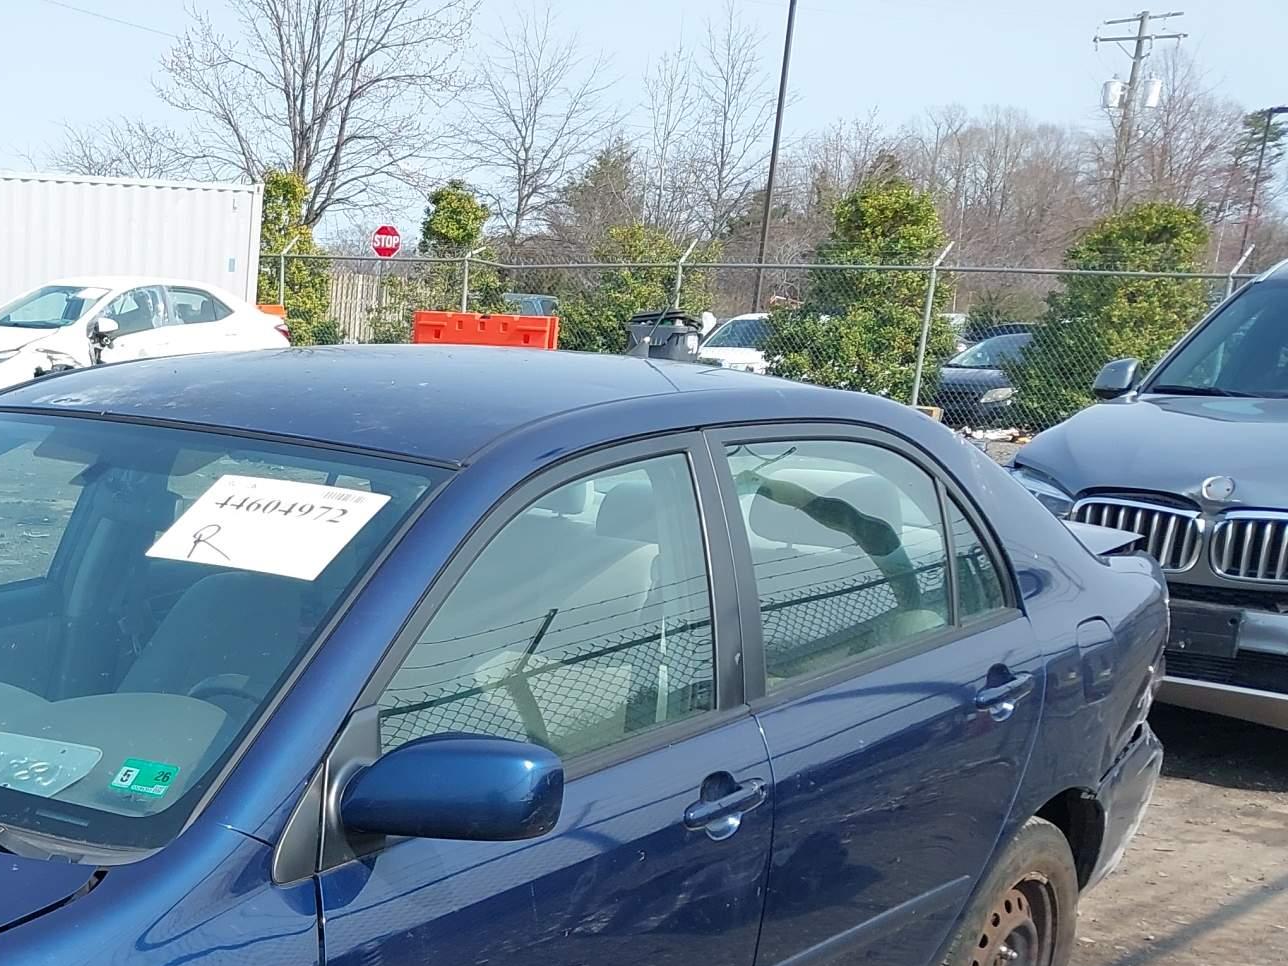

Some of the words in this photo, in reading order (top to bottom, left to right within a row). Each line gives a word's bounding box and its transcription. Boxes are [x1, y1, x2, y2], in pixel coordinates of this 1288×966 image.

[373, 234, 399, 248] STOP
[215, 494, 349, 524] 44604972
[120, 769, 134, 783] 5
[154, 770, 172, 783] 26
